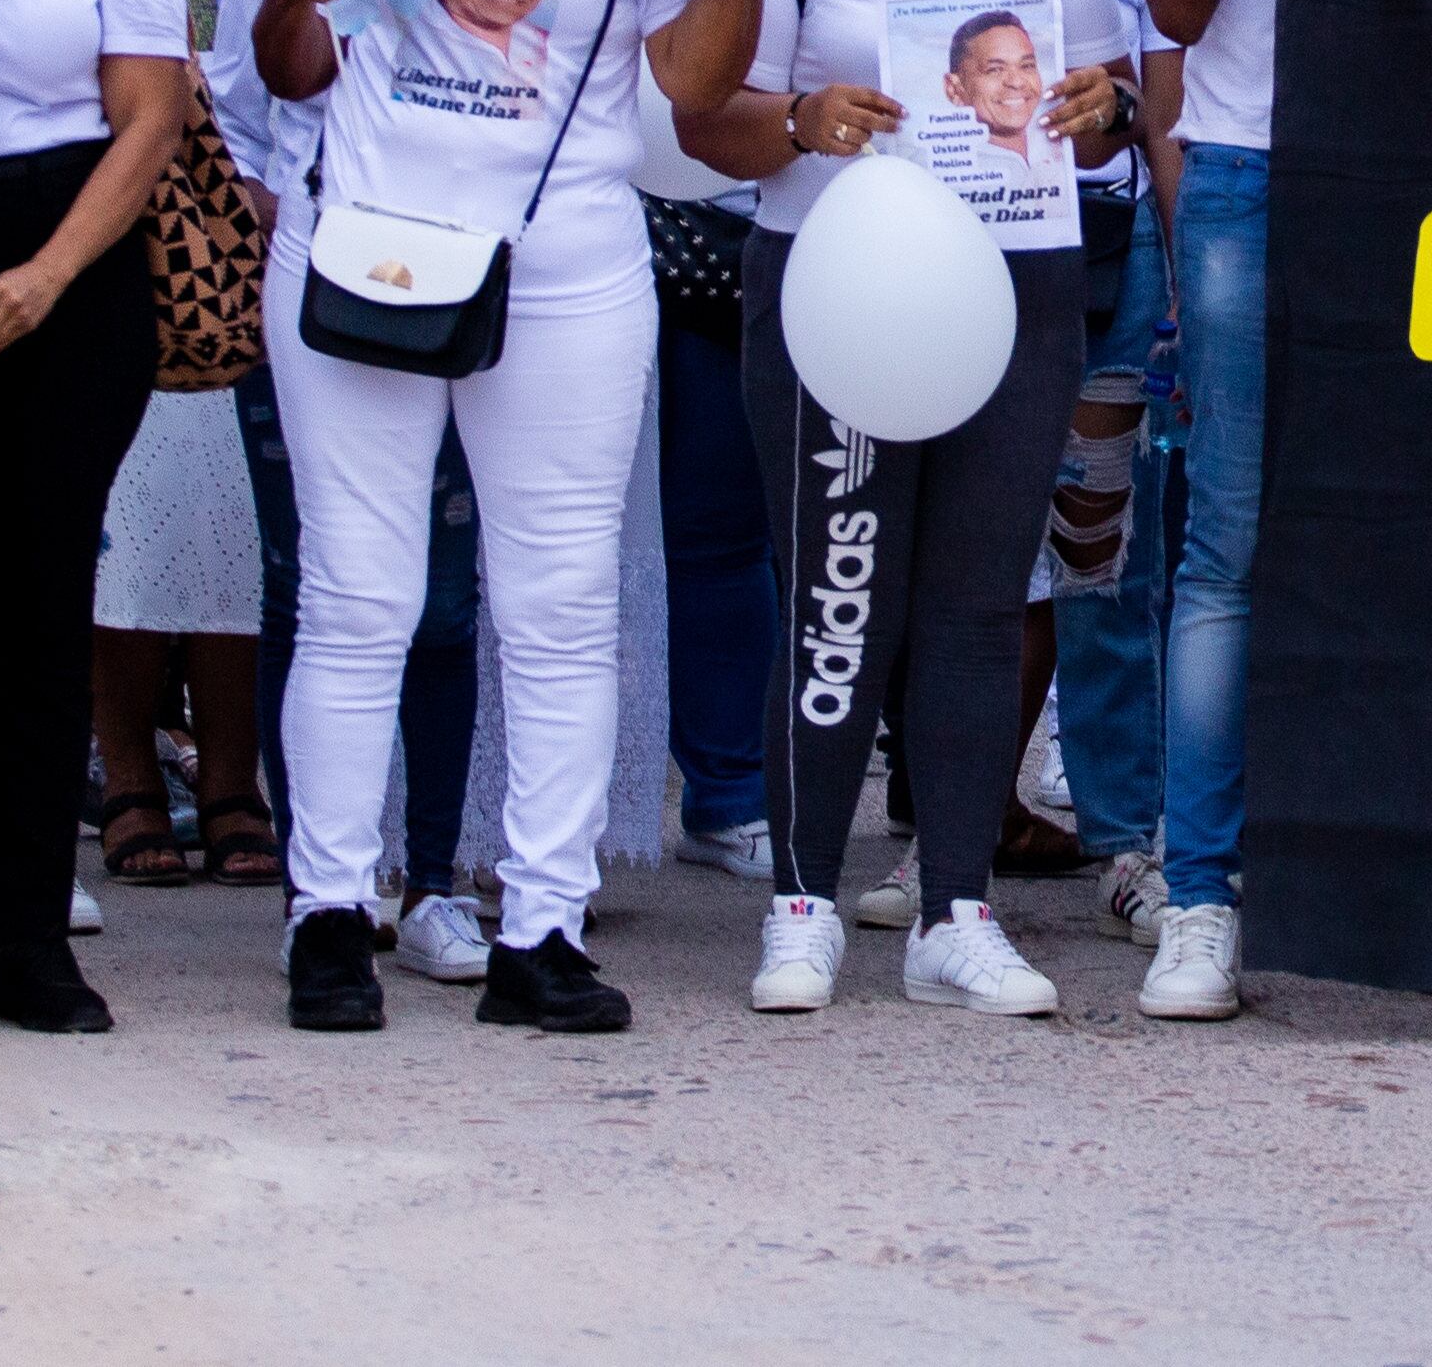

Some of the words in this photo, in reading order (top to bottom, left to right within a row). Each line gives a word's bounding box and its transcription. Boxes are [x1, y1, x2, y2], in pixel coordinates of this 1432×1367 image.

[396, 66, 483, 95] Libertad
[485, 83, 539, 100] para
[408, 90, 466, 113] Mane
[929, 113, 971, 124] Familia
[917, 128, 984, 141] Campuzano
[932, 143, 971, 155] Ustate
[932, 158, 973, 169] Molina
[943, 175, 958, 183] en
[960, 171, 1004, 182] oración
[959, 186, 1005, 204] rtad
[1008, 185, 1060, 205] para
[995, 206, 1045, 223] Díaz
[800, 510, 878, 726] adidas
